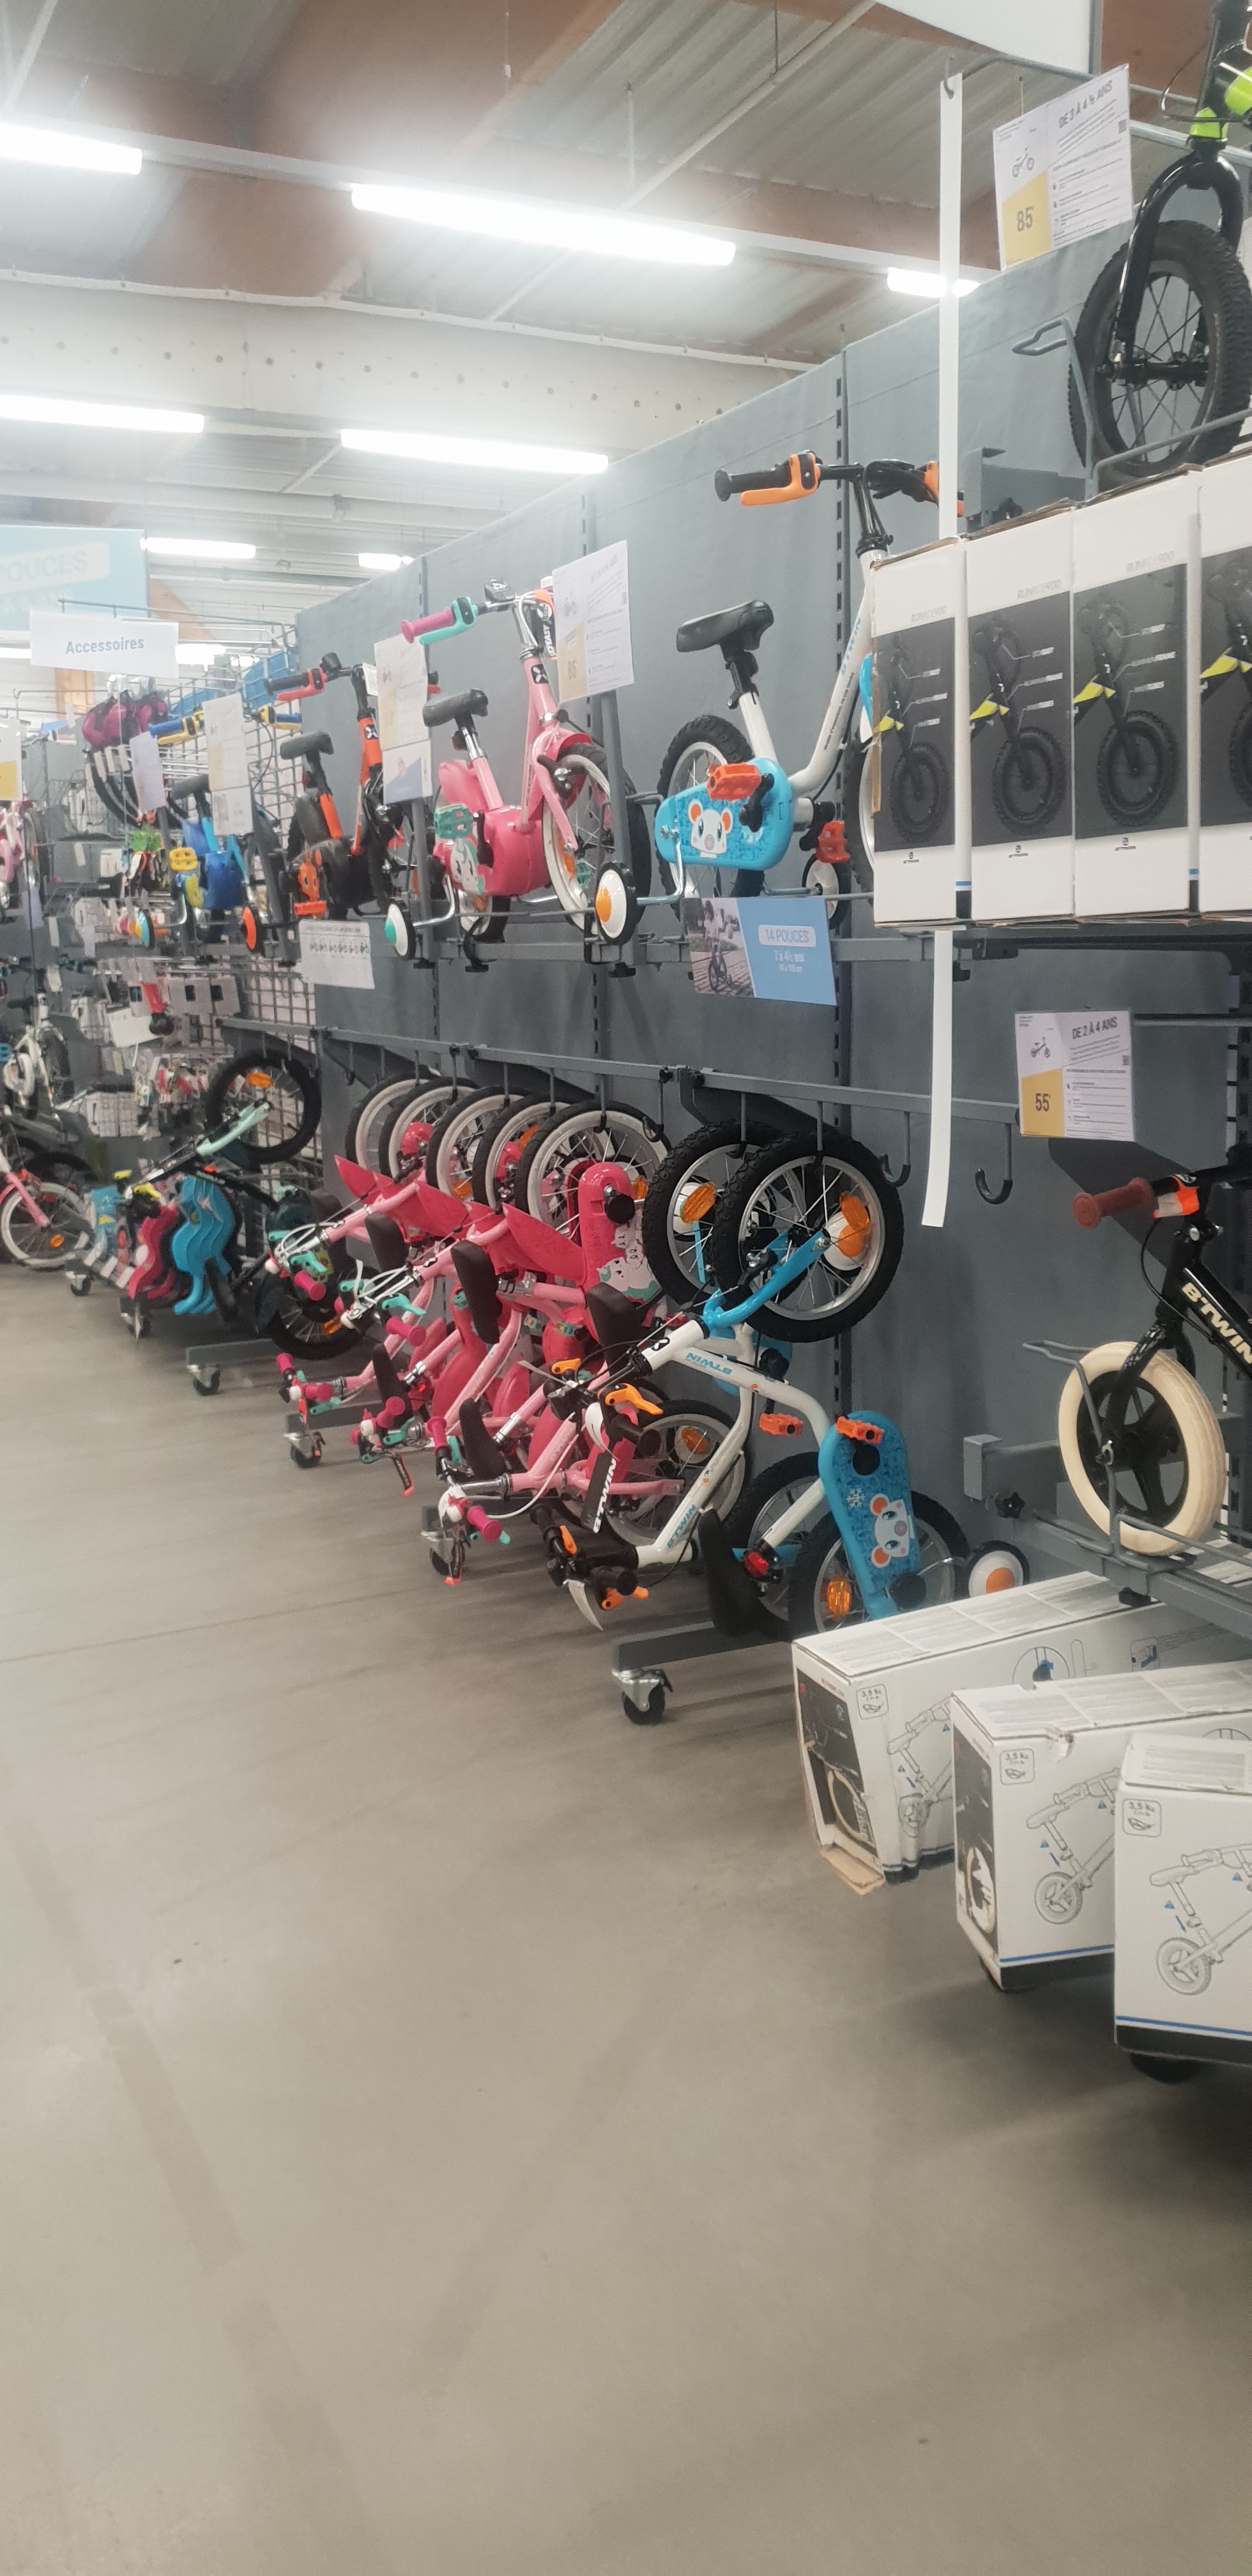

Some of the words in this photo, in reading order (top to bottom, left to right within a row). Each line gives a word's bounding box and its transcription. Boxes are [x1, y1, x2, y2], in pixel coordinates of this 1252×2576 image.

[65, 637, 145, 655] Accessoires
[775, 929, 810, 944] POUCES
[1072, 1026, 1082, 1040] DE
[1083, 1025, 1088, 1036] 2
[1096, 1021, 1100, 1032] 4
[1101, 1016, 1118, 1032] ANS
[1182, 1282, 1252, 1365] B'TWIN
